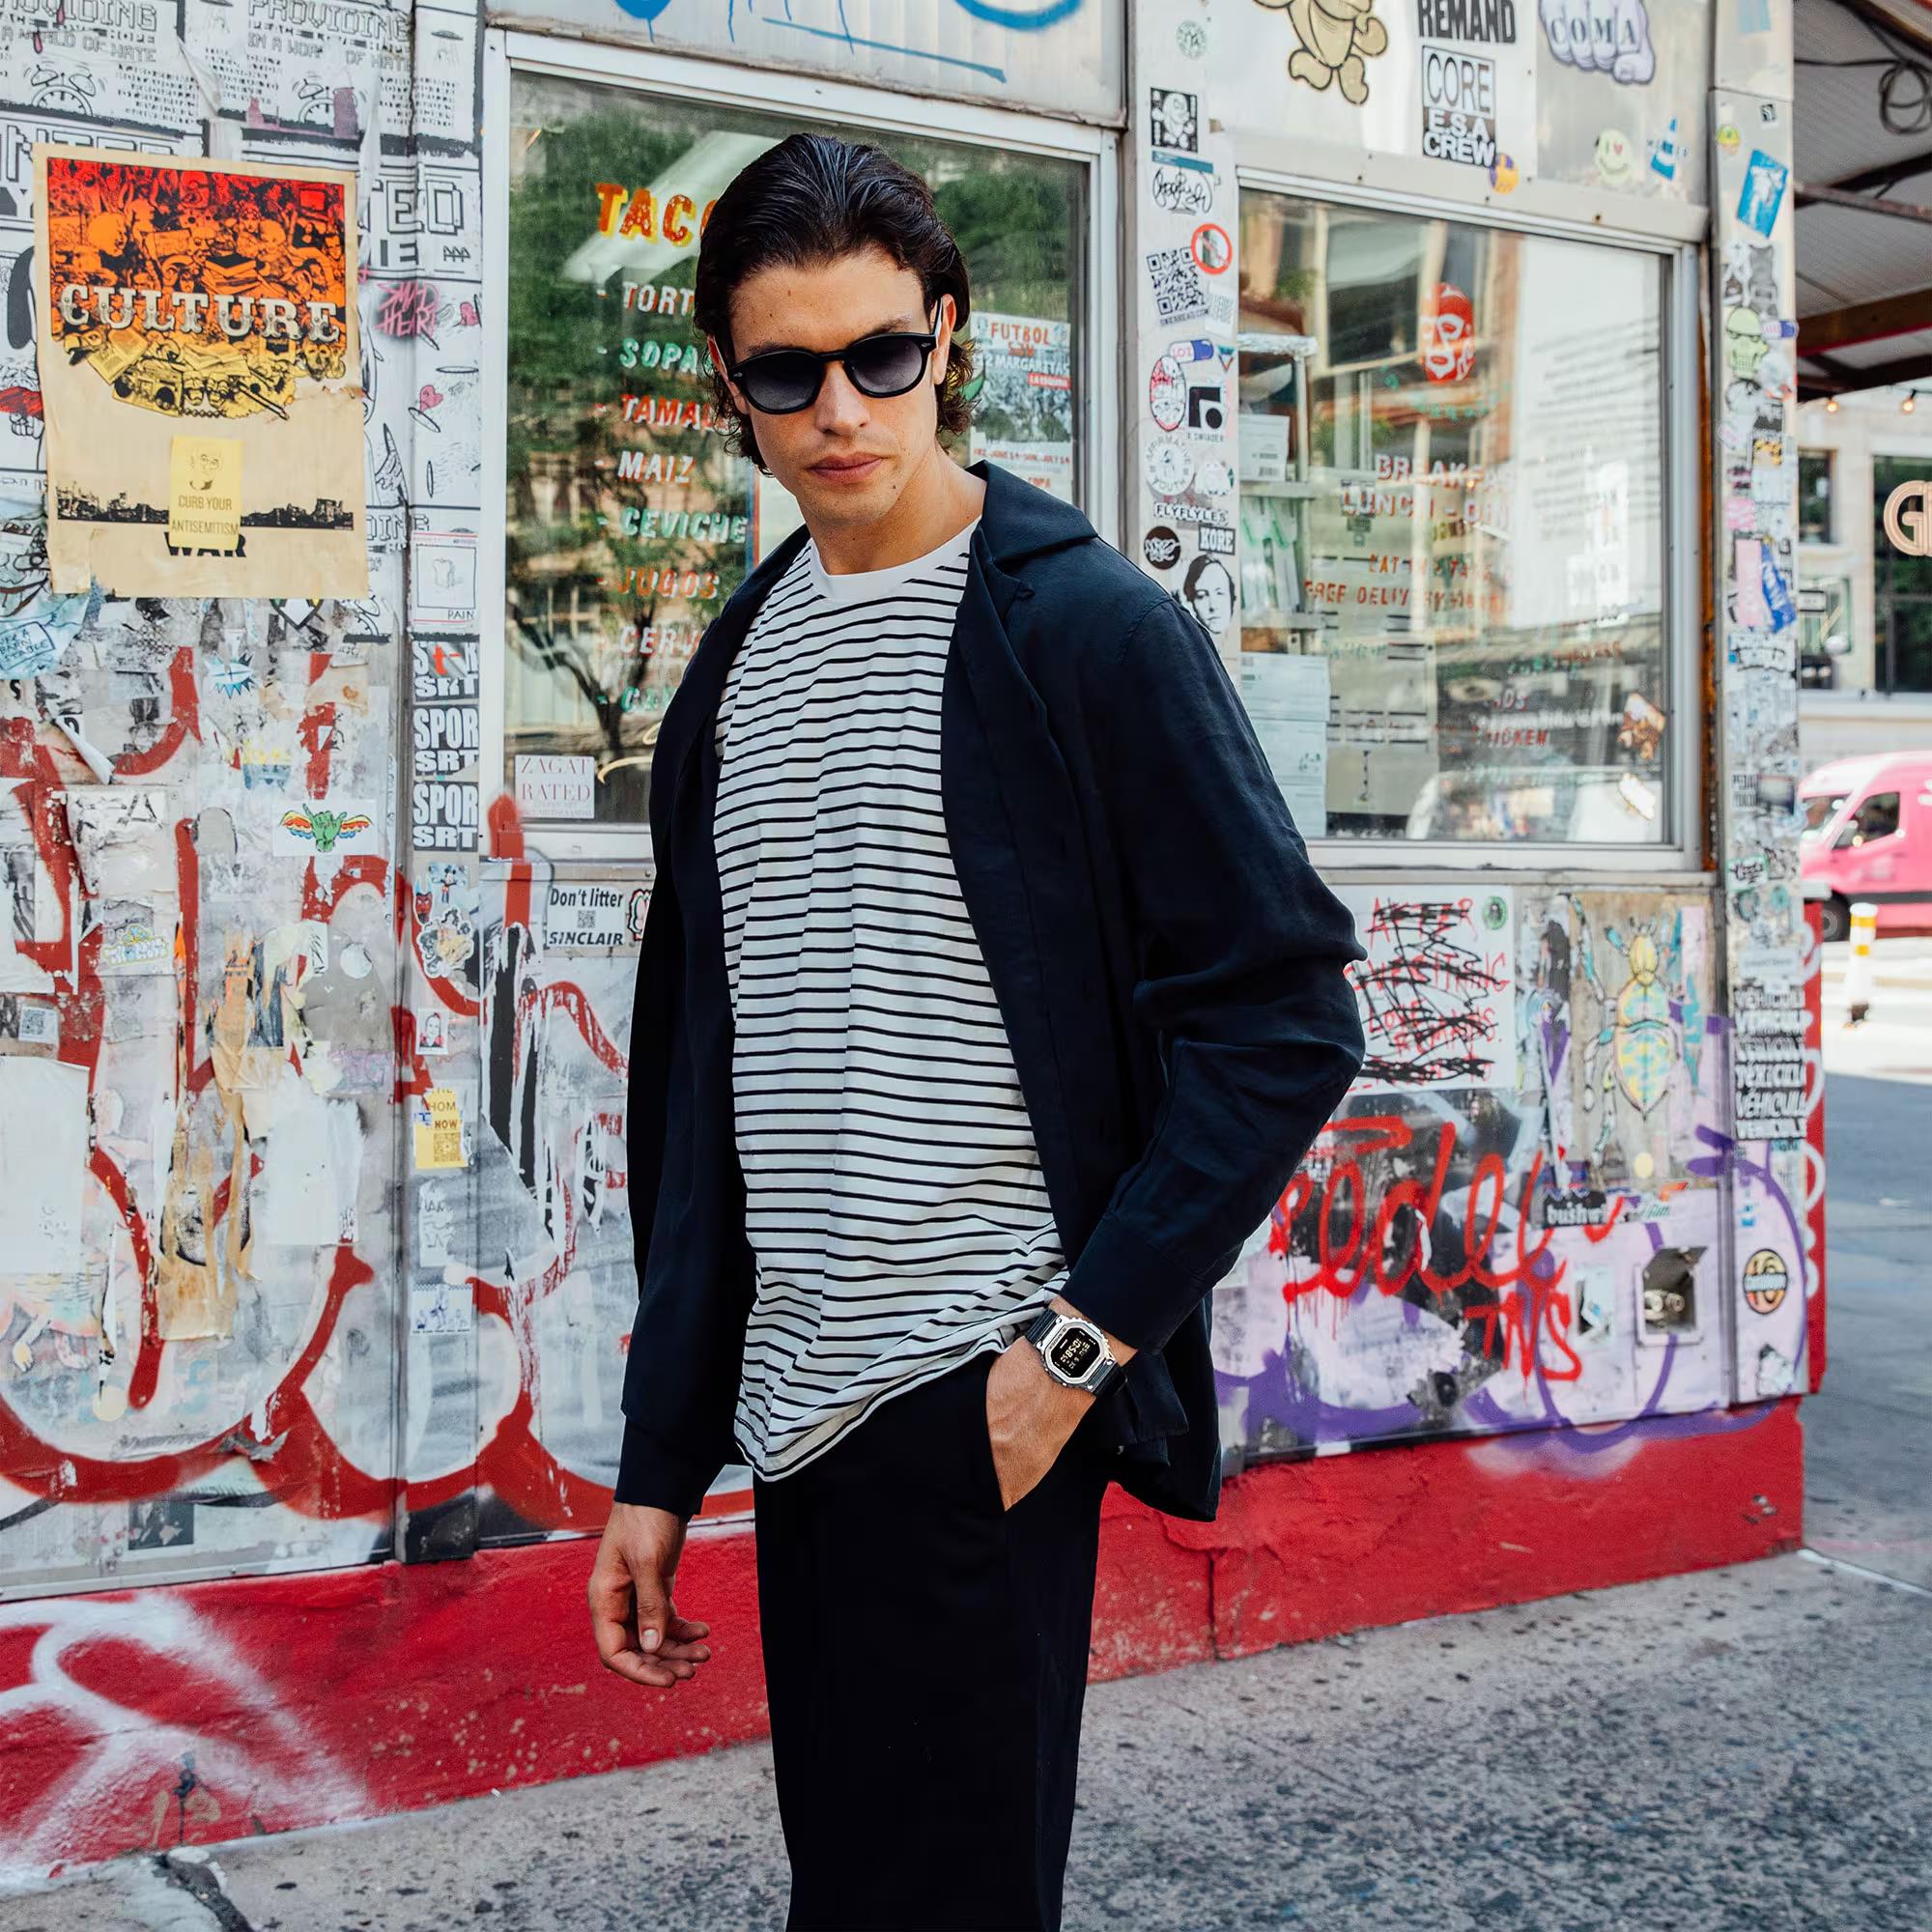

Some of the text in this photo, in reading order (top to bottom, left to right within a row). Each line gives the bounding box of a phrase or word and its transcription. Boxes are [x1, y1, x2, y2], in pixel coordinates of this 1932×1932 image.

[1417, 0, 1516, 43] REMAND
[1551, 17, 1636, 44] COMA
[1427, 53, 1491, 113] CORE
[1423, 130, 1496, 167] CREW
[60, 283, 341, 344] CULTURE
[990, 322, 1051, 346] FUTBOL
[619, 337, 713, 377] SOPA
[618, 450, 696, 484] MAIZ
[178, 495, 232, 511] CURB YOUR
[171, 519, 239, 536] ANTISEMITISM
[620, 507, 748, 545] CEVICHE
[617, 567, 720, 601] JUGOS
[1305, 580, 1347, 604] FREE
[1357, 585, 1445, 611] DELIVRY
[415, 749, 478, 773] SRT
[522, 757, 590, 775] ZAGAT
[522, 783, 590, 801] RATED
[413, 826, 477, 848] SRT
[550, 888, 623, 908] Don't litter
[549, 931, 623, 946] SINCLAIR
